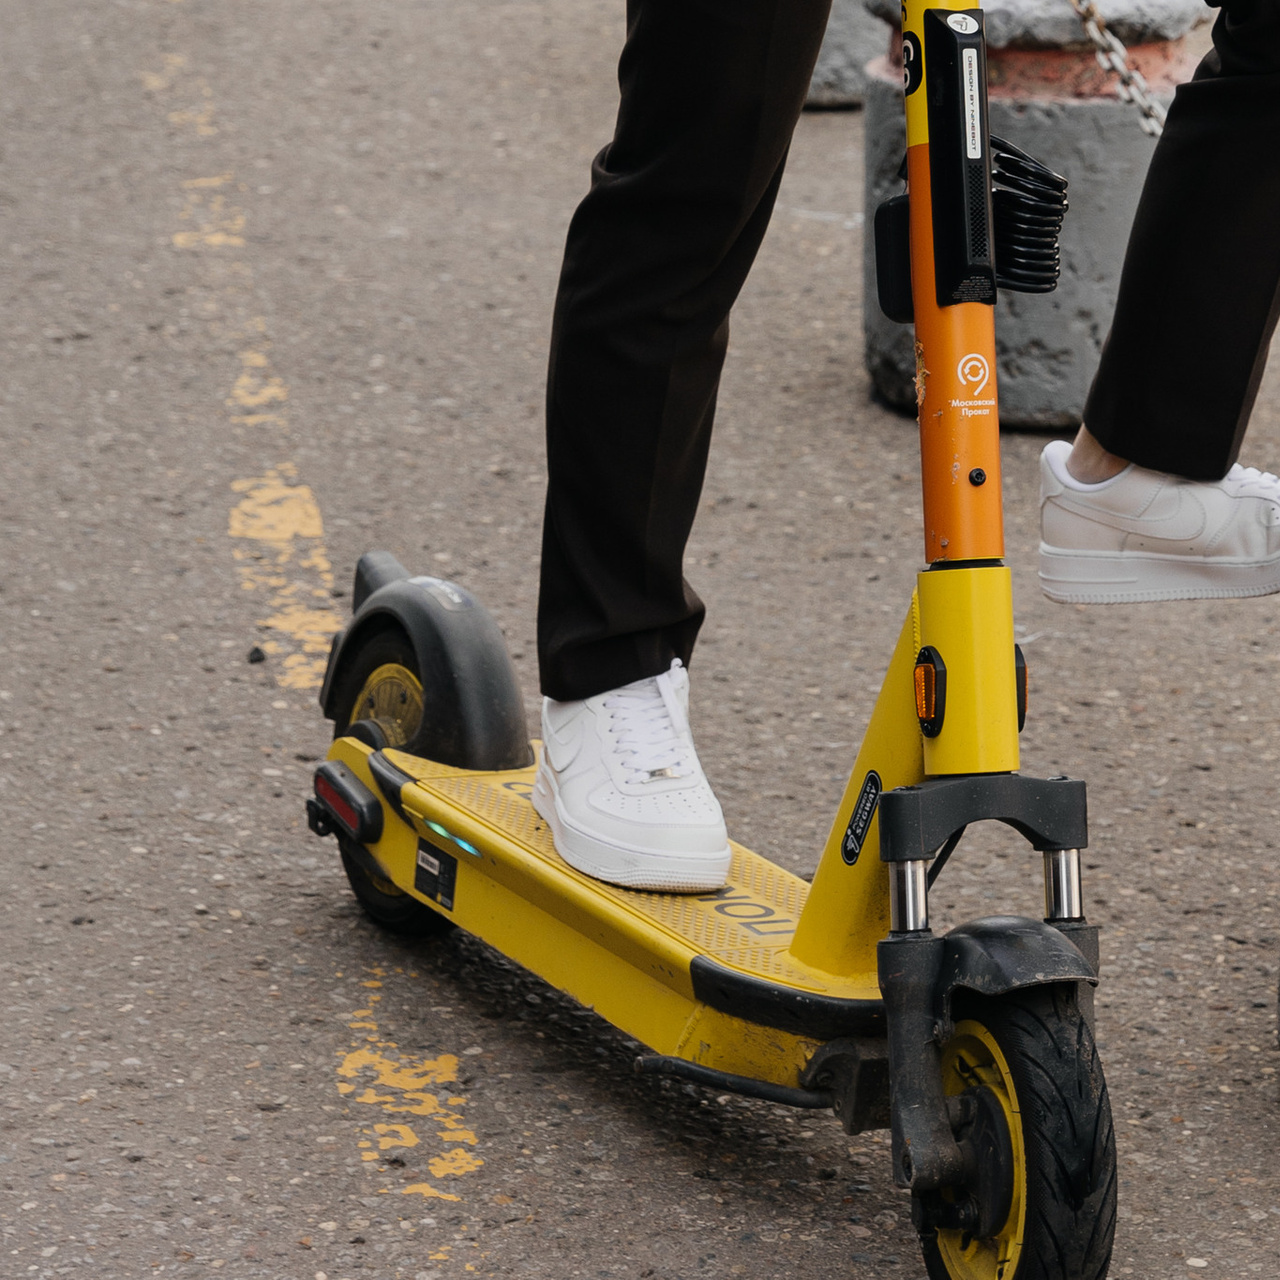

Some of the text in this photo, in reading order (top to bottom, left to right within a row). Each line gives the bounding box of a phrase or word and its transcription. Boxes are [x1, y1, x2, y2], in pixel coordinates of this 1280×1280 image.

[969, 94, 975, 107] BY
[951, 398, 995, 407] Московский
[961, 408, 990, 417] Прокат
[852, 792, 868, 830] POWERED
[856, 785, 877, 836] SEGWAY
